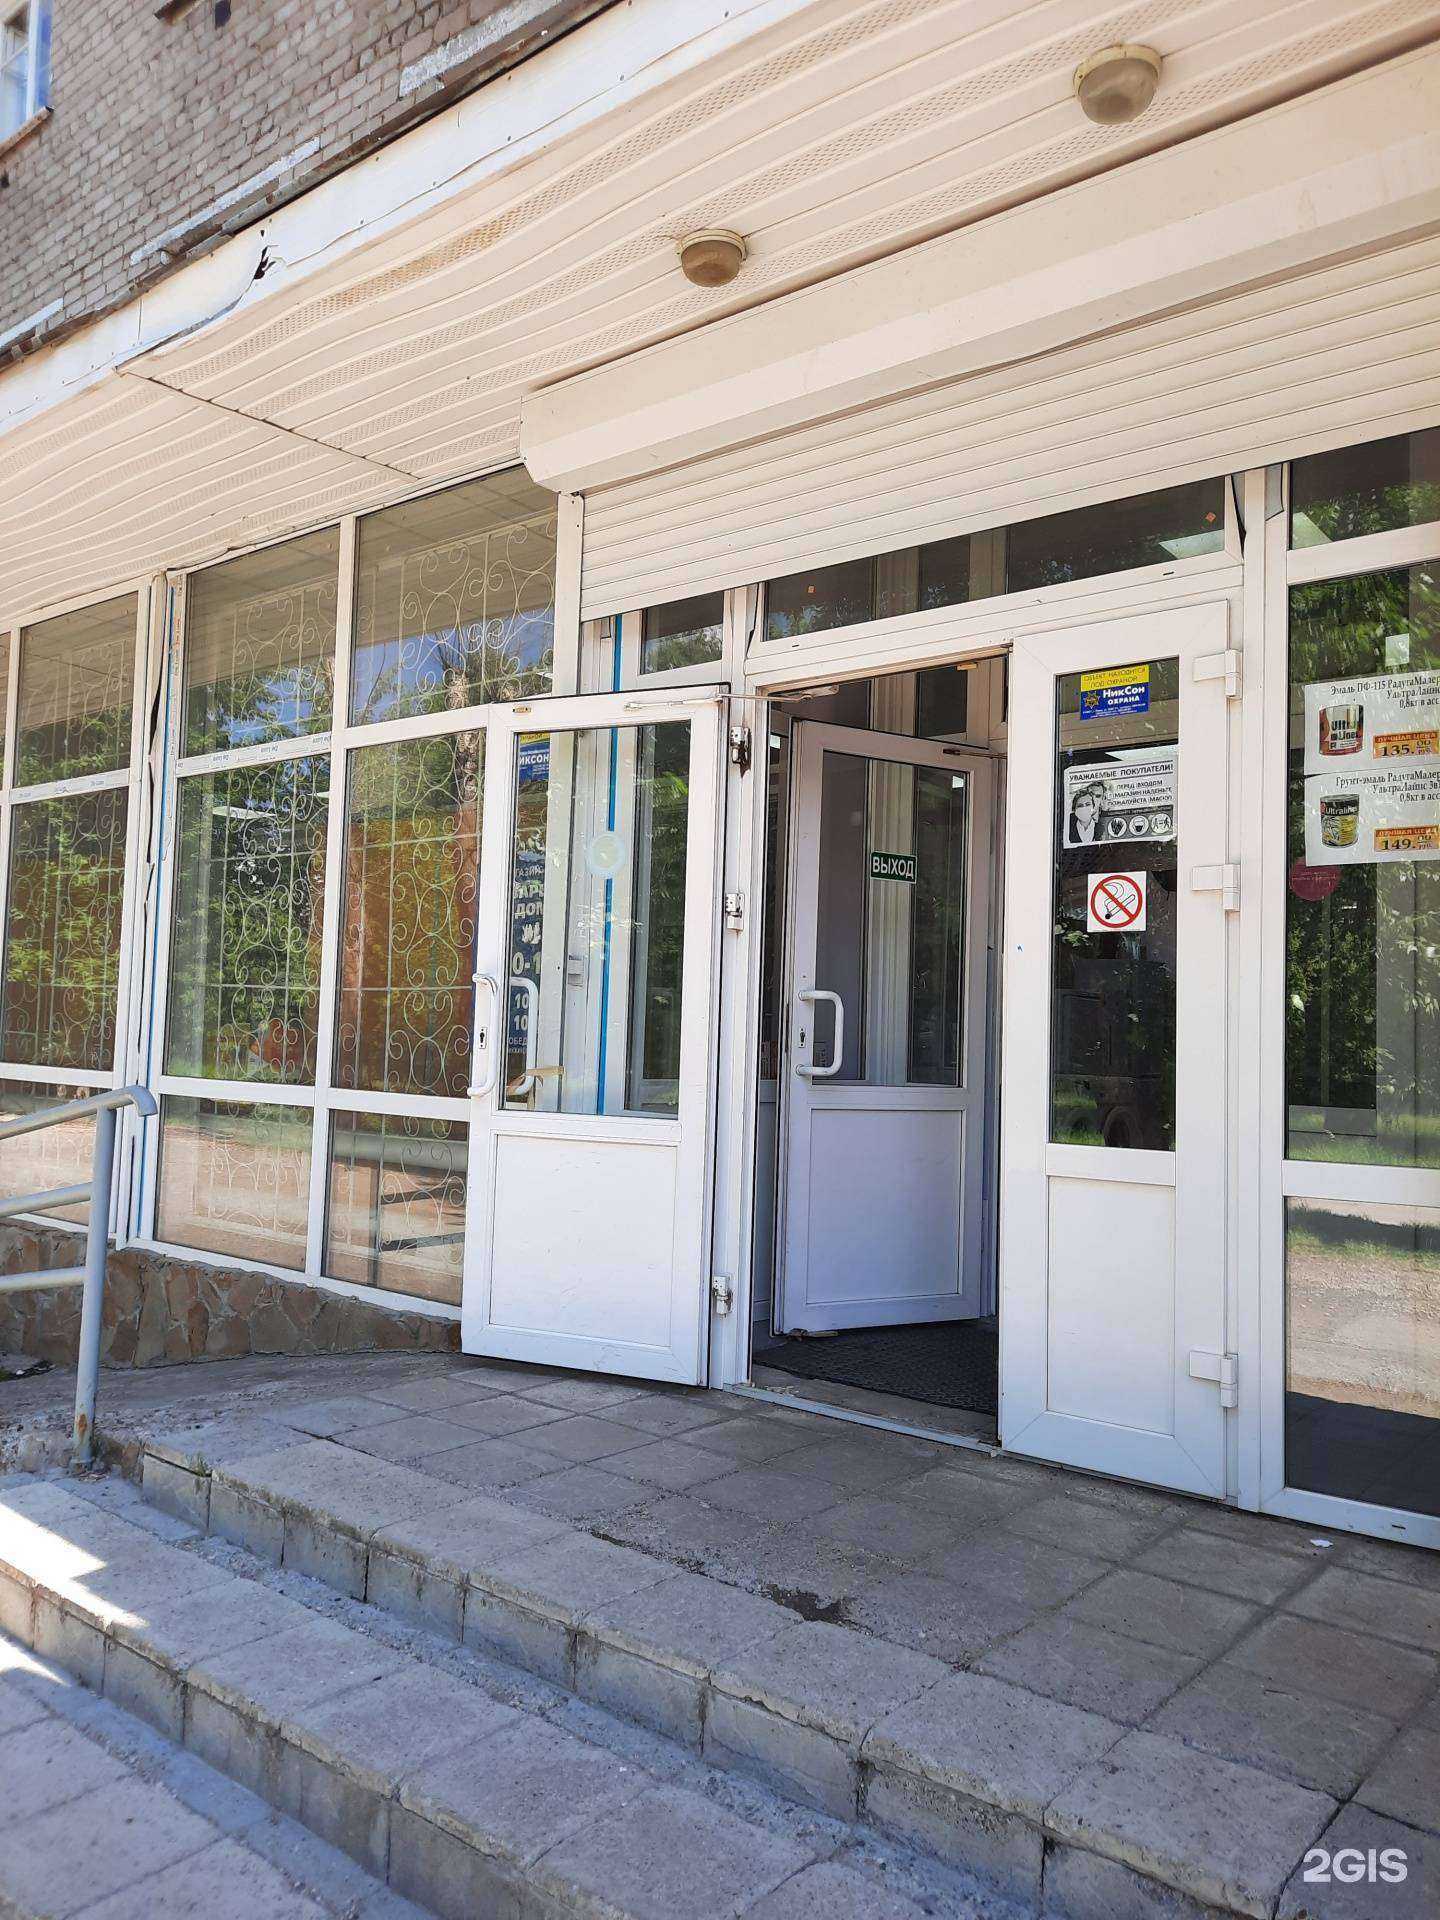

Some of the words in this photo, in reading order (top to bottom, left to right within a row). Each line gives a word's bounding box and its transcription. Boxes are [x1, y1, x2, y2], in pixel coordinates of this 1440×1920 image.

[1102, 686, 1146, 699] НикСон
[1330, 685, 1355, 696] Эмаль
[1357, 680, 1386, 693] ПФ-115
[1107, 696, 1140, 706] ОХРАНА
[519, 753, 550, 766] ИКСОН
[1069, 771, 1118, 782] УВАЖАЕМЫЕ
[1120, 763, 1174, 776] ПОКУПАТЕЛИ!
[1116, 783, 1136, 791] ПЕРЕД
[1137, 779, 1163, 788] ВХОДОМ
[1336, 775, 1386, 789] Грунт-эмаль
[1372, 781, 1427, 796] УльтраЛайнс
[1113, 790, 1142, 799] МАГАЗИН
[1142, 786, 1172, 796] НАДЕНЬТЕ
[1107, 798, 1147, 807] ПОЖАЛУЙСТА
[872, 856, 914, 880] ВЫХОД
